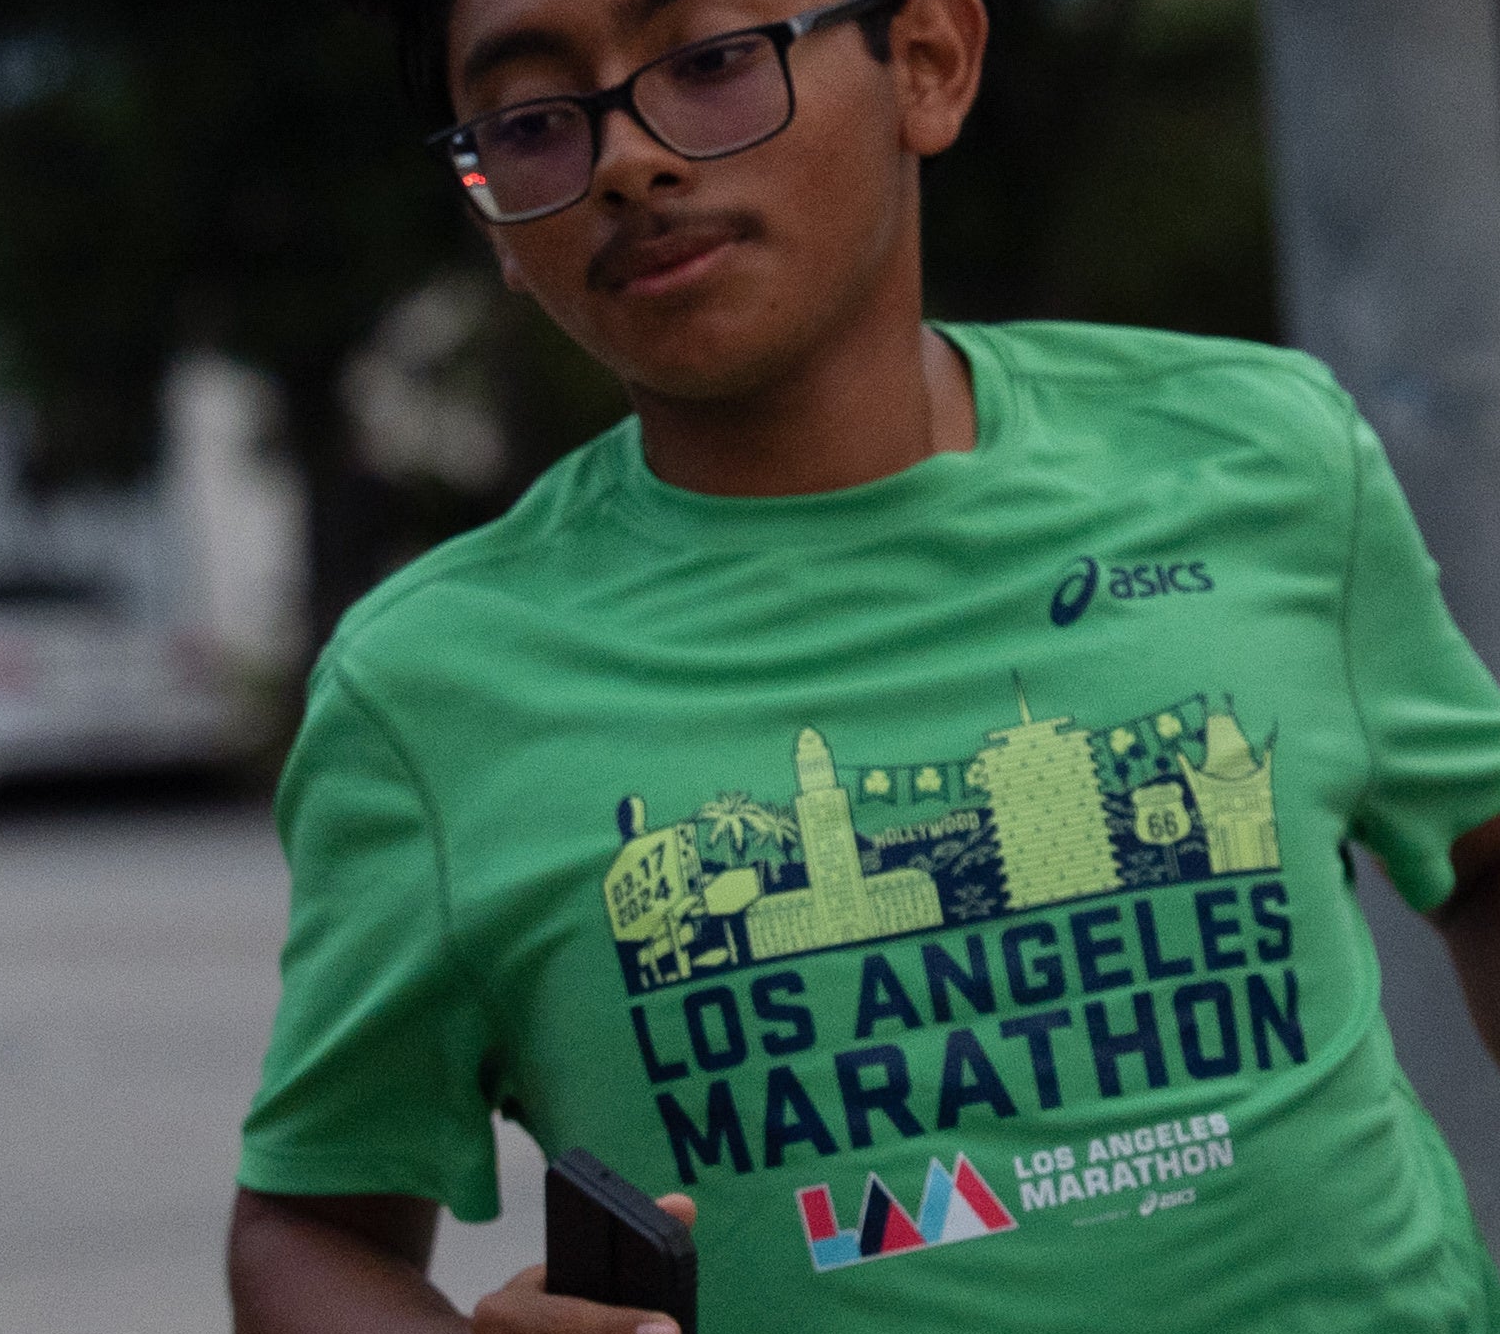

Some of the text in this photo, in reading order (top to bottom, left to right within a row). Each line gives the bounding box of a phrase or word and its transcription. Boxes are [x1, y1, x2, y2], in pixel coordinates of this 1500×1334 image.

[1146, 810, 1179, 839] 66
[617, 875, 673, 928] 2024
[629, 881, 1296, 1084] LOS ANGELES
[655, 970, 1310, 1185] MARATHON
[1013, 1113, 1230, 1179] LOS ANGELES
[1018, 1138, 1235, 1212] MARATHON
